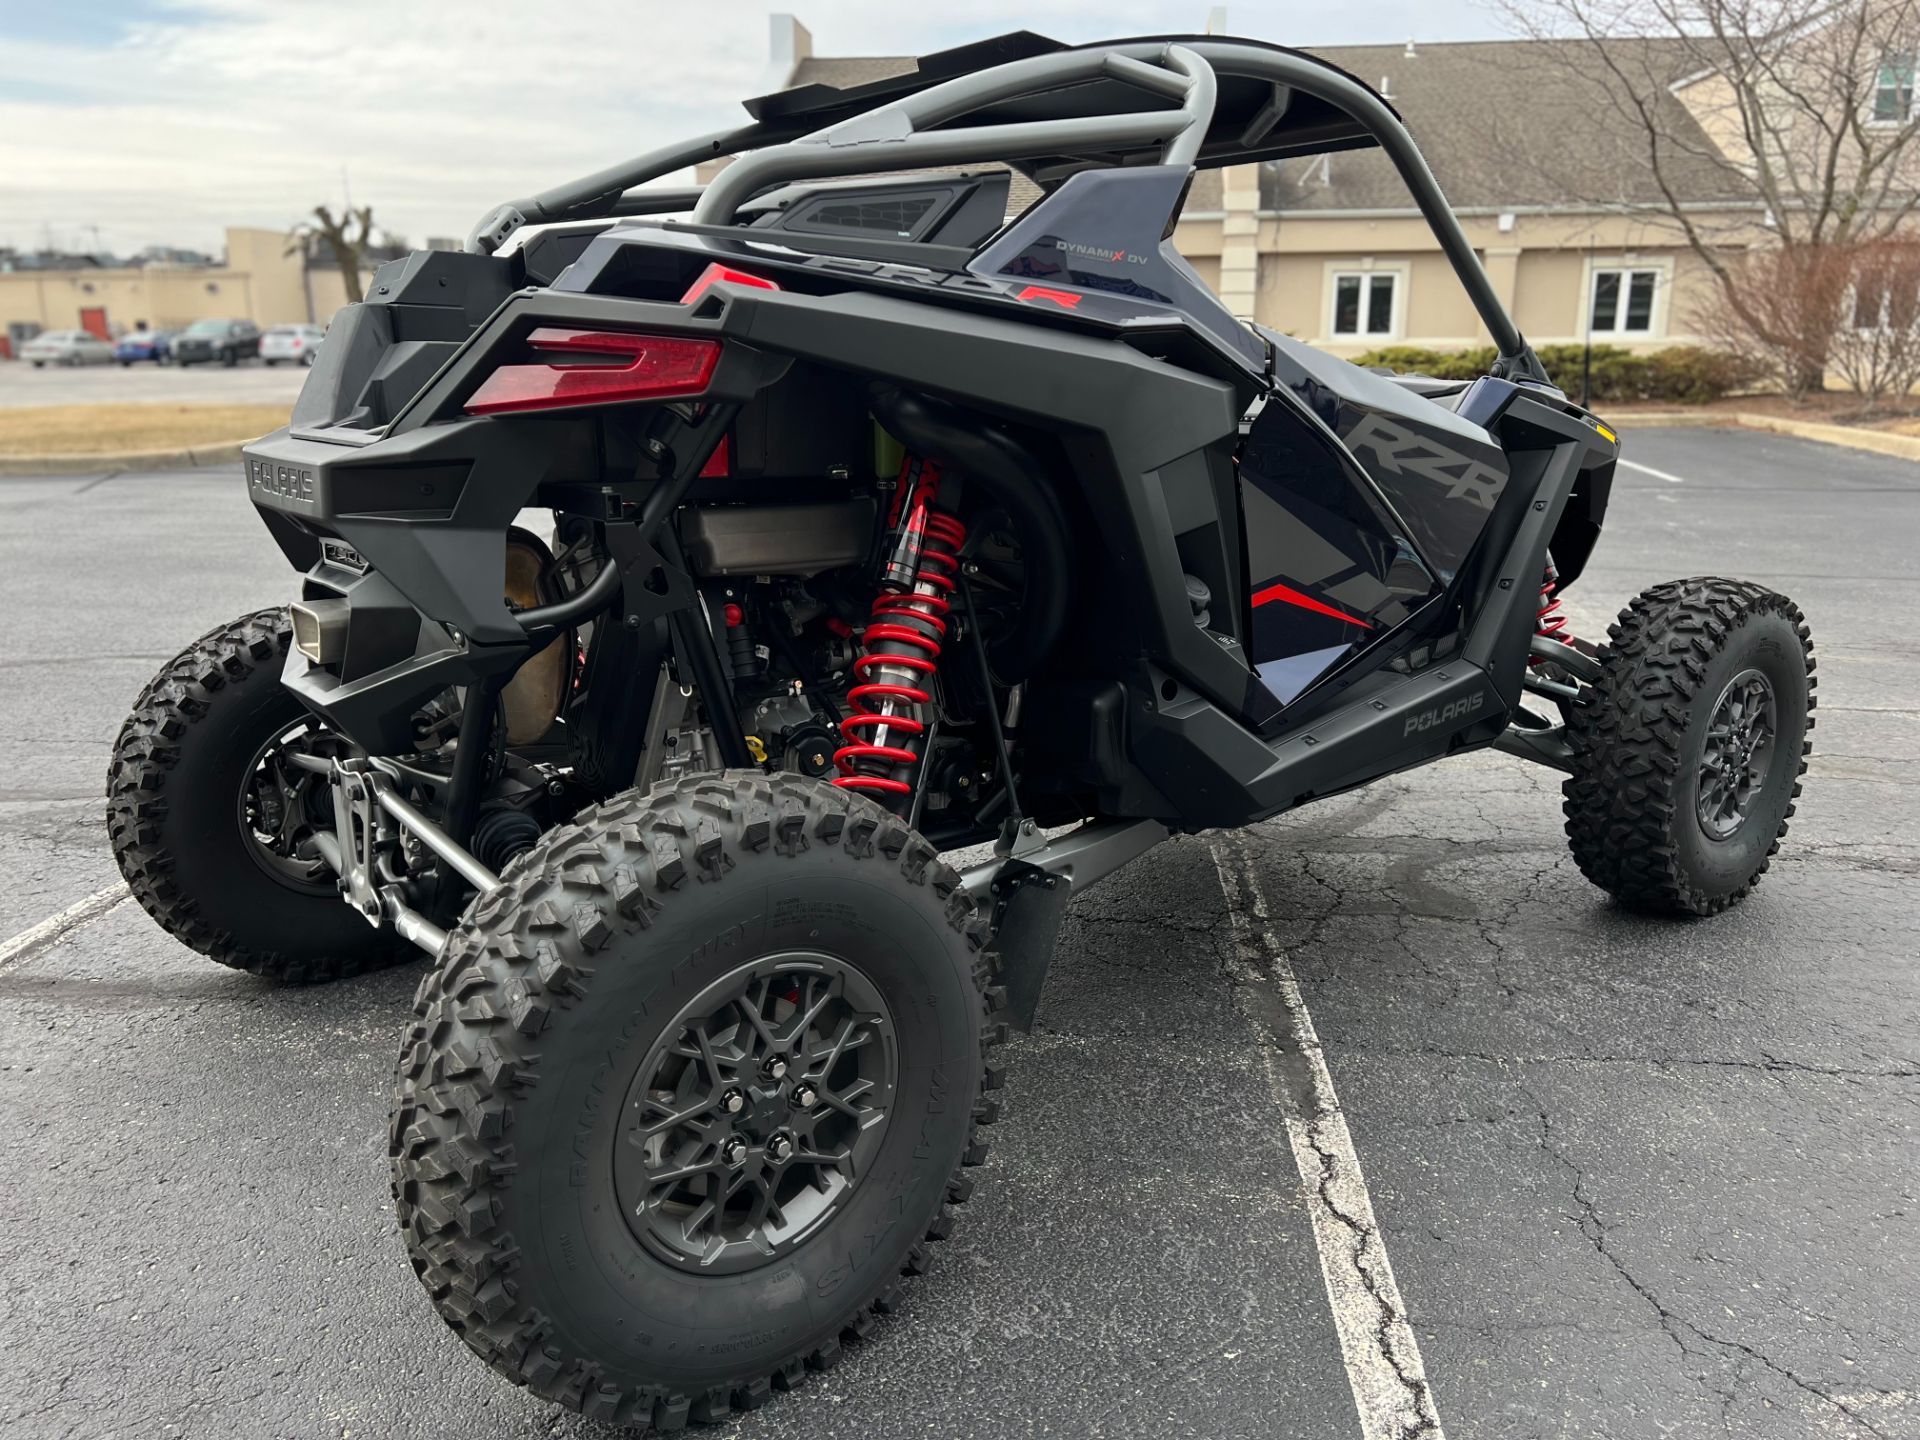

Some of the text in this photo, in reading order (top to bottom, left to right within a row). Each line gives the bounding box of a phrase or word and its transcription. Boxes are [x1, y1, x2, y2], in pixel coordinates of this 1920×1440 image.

[1056, 240, 1125, 263] DYNAMIX
[1127, 254, 1148, 265] DV
[250, 459, 315, 503] POLARIS
[1342, 412, 1510, 511] RZR
[1403, 690, 1485, 738] POLARIS
